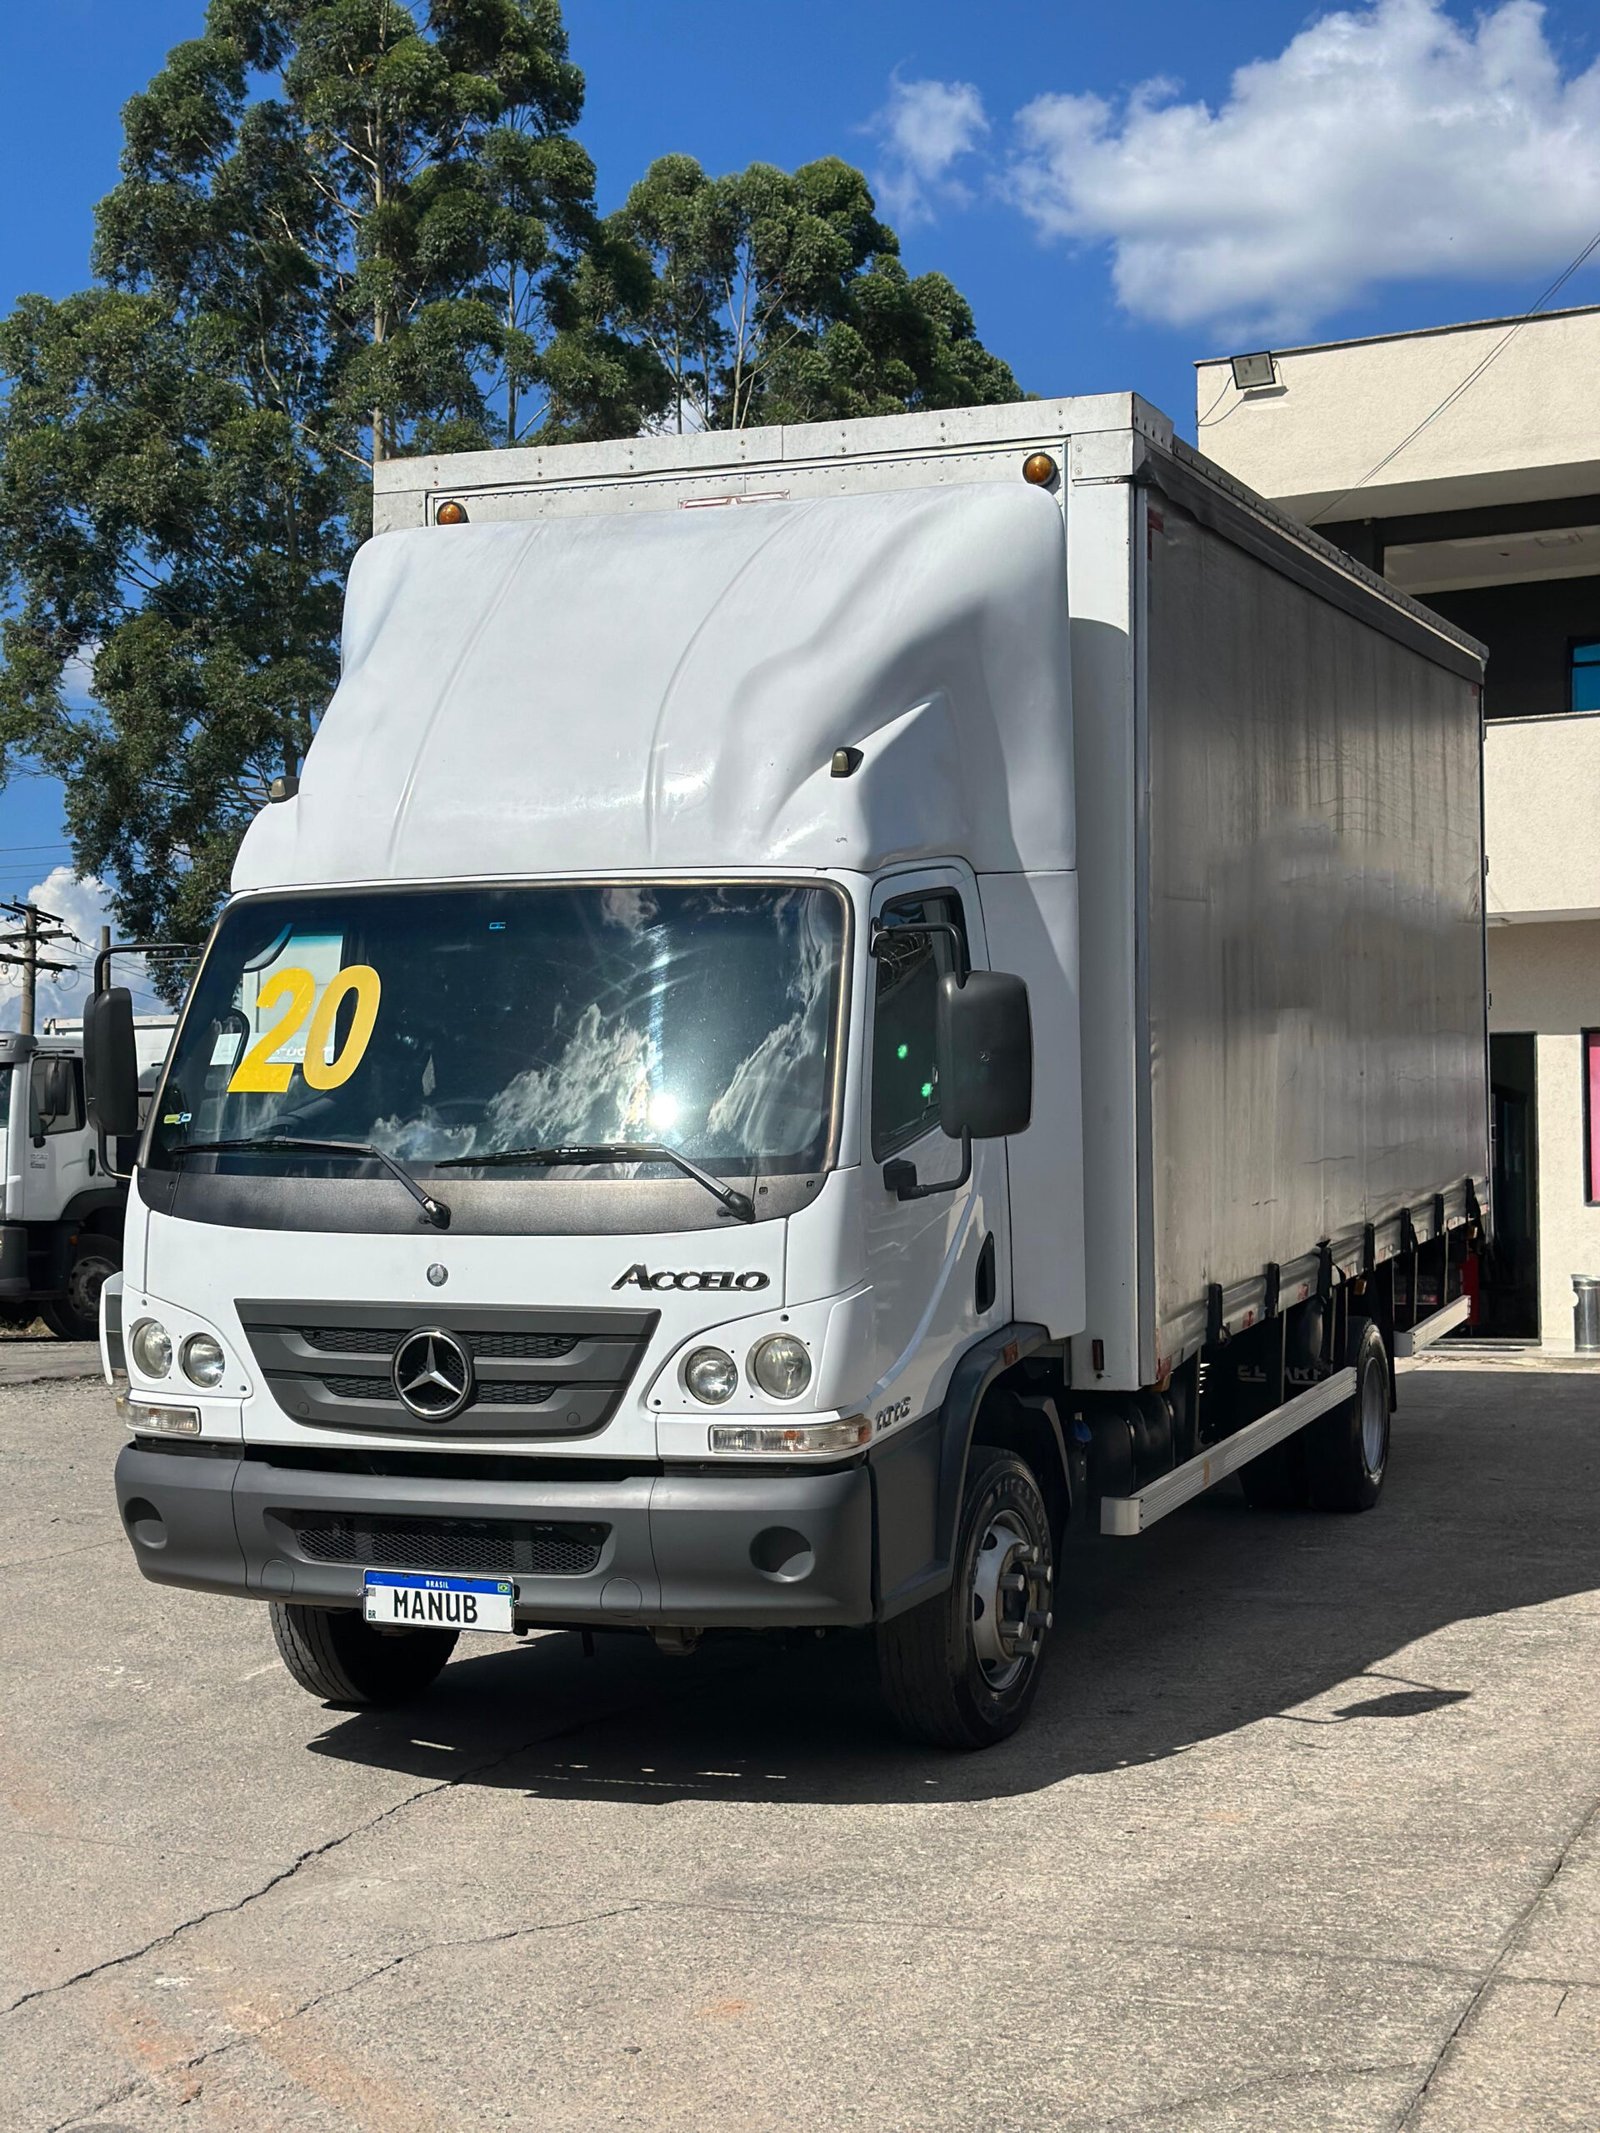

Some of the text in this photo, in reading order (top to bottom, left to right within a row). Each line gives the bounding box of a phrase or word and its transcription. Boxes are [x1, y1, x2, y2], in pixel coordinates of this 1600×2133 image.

[227, 965, 381, 1093] 20
[425, 1580, 449, 1589] BRASIL
[368, 1609, 377, 1619] BR
[393, 1589, 478, 1624] MANUB
